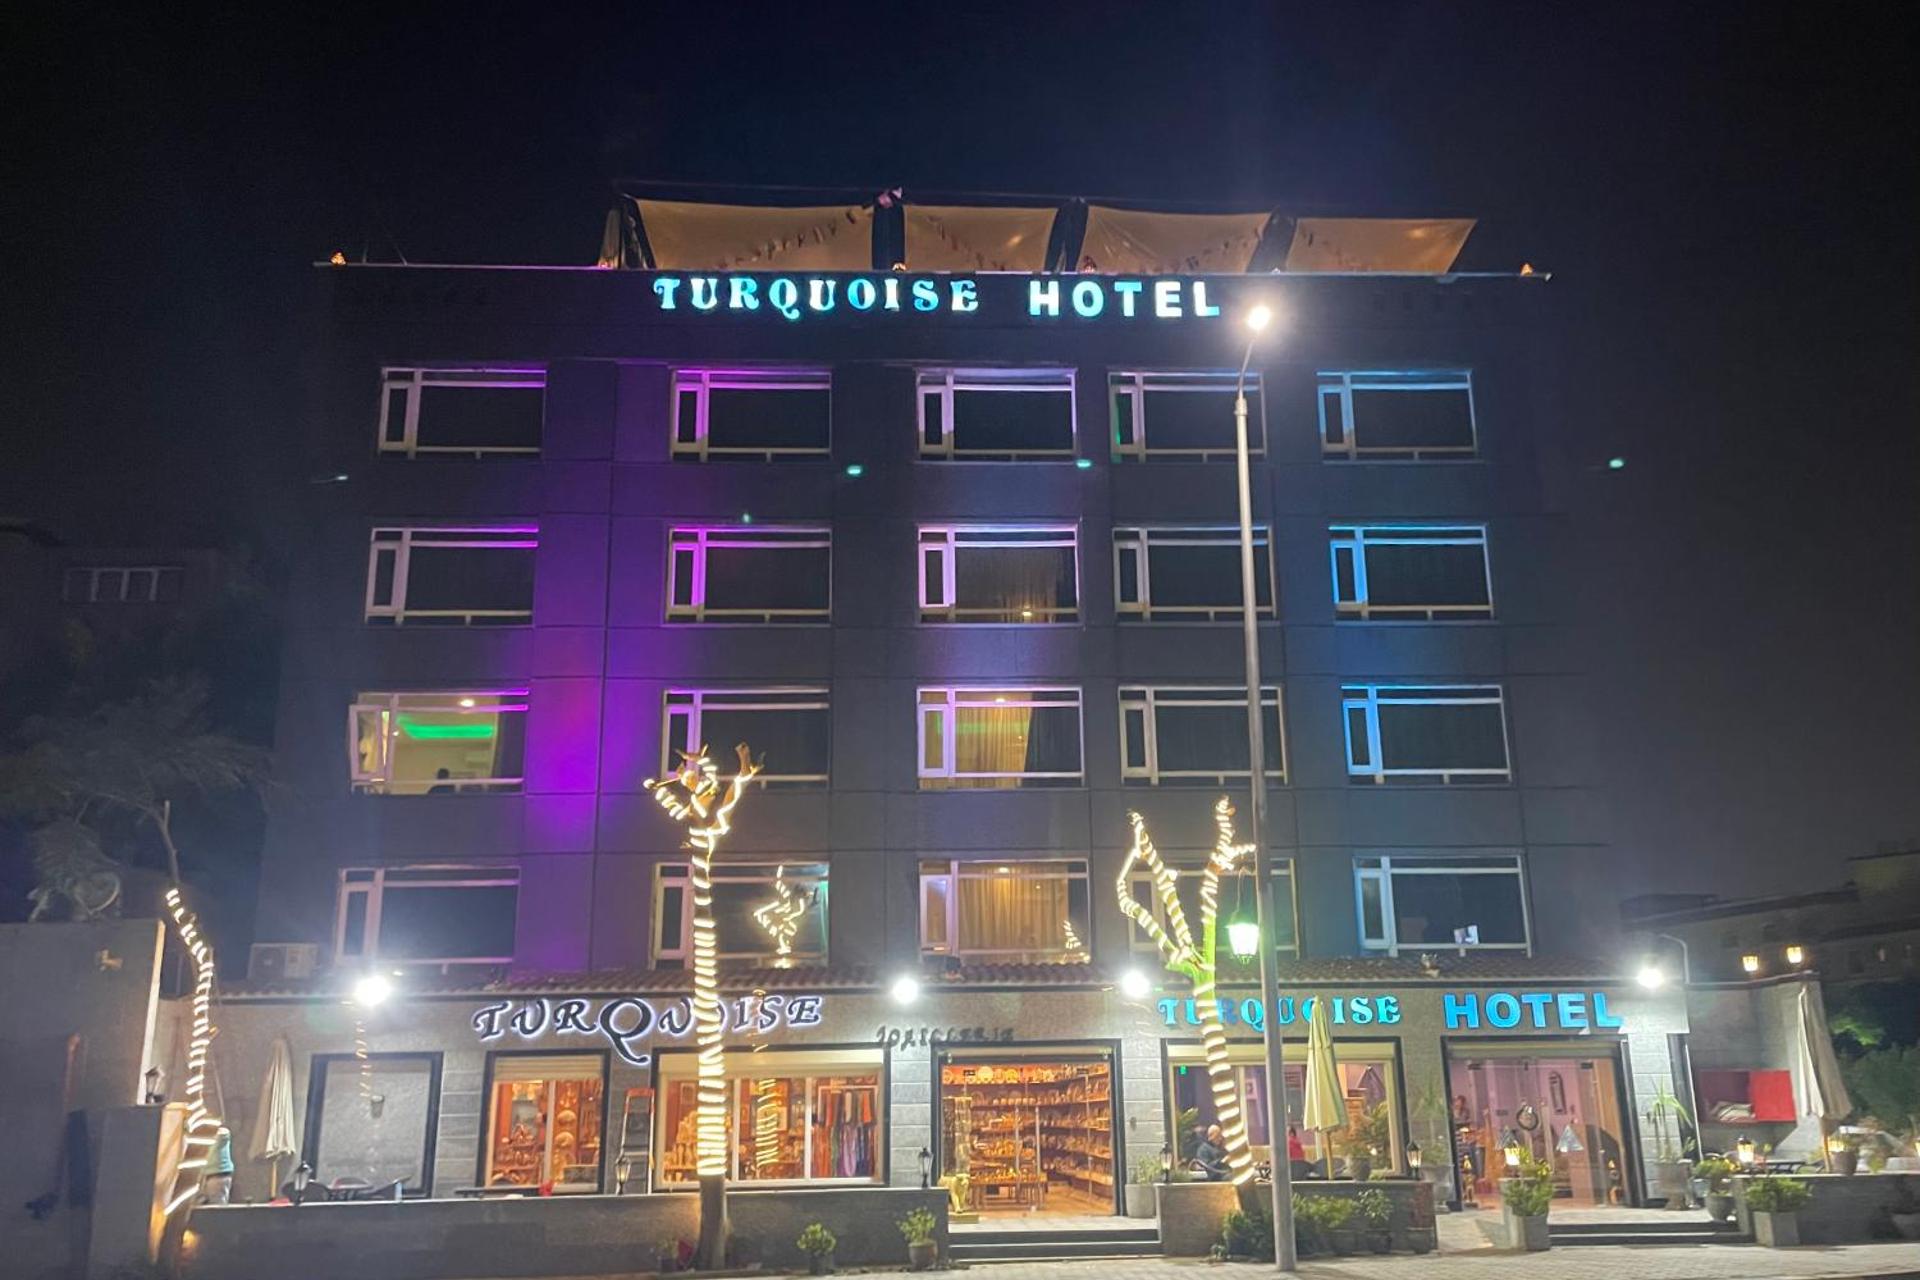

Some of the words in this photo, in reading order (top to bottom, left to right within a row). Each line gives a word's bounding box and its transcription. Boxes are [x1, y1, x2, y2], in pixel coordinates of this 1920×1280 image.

[652, 276, 980, 320] TURQUOISE
[1028, 280, 1221, 317] HOTEL
[1443, 992, 1624, 1029] HOTEL
